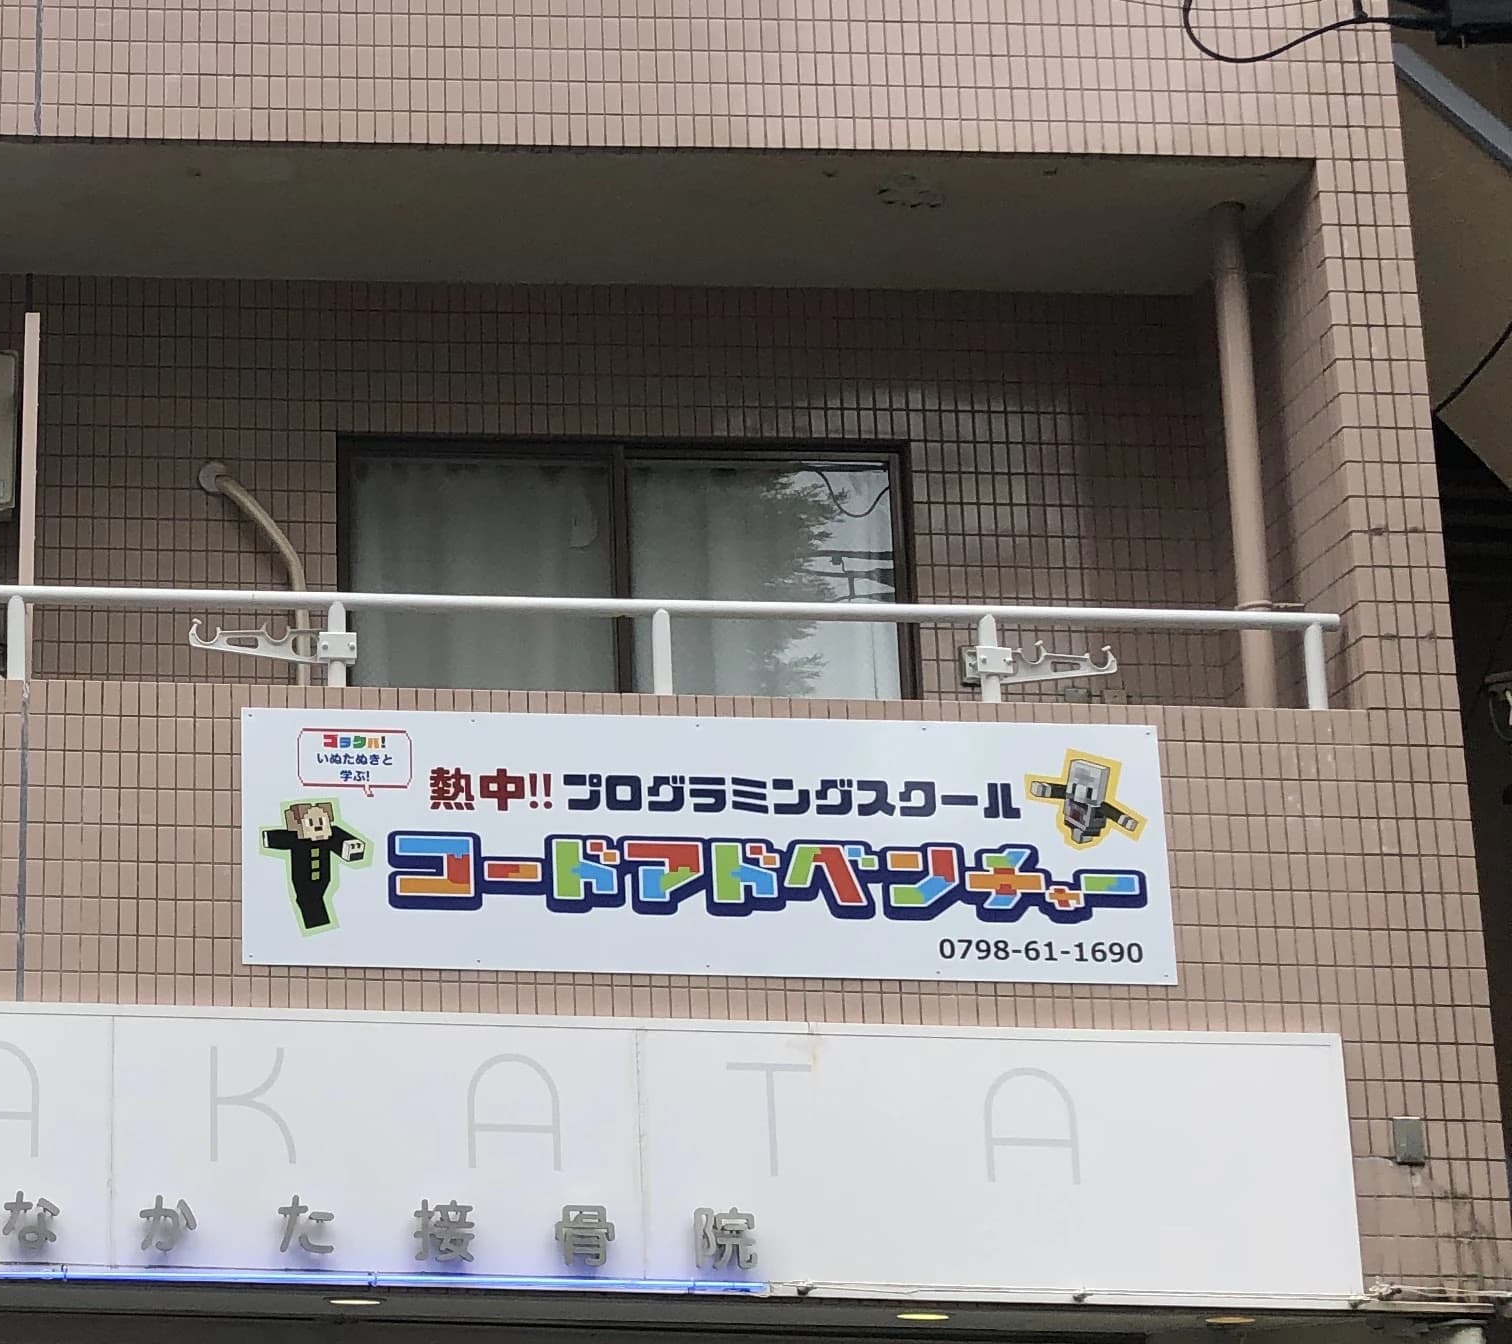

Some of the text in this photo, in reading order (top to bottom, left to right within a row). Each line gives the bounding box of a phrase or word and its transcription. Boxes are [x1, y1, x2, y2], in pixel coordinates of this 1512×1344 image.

[317, 752, 393, 766] いぬたぬきと
[339, 769, 370, 782] 学ぶ!
[388, 830, 1148, 921] コードアドベンチャー
[937, 936, 1144, 965] 0798-61-1690
[3, 1190, 756, 1269] なかた接骨院
